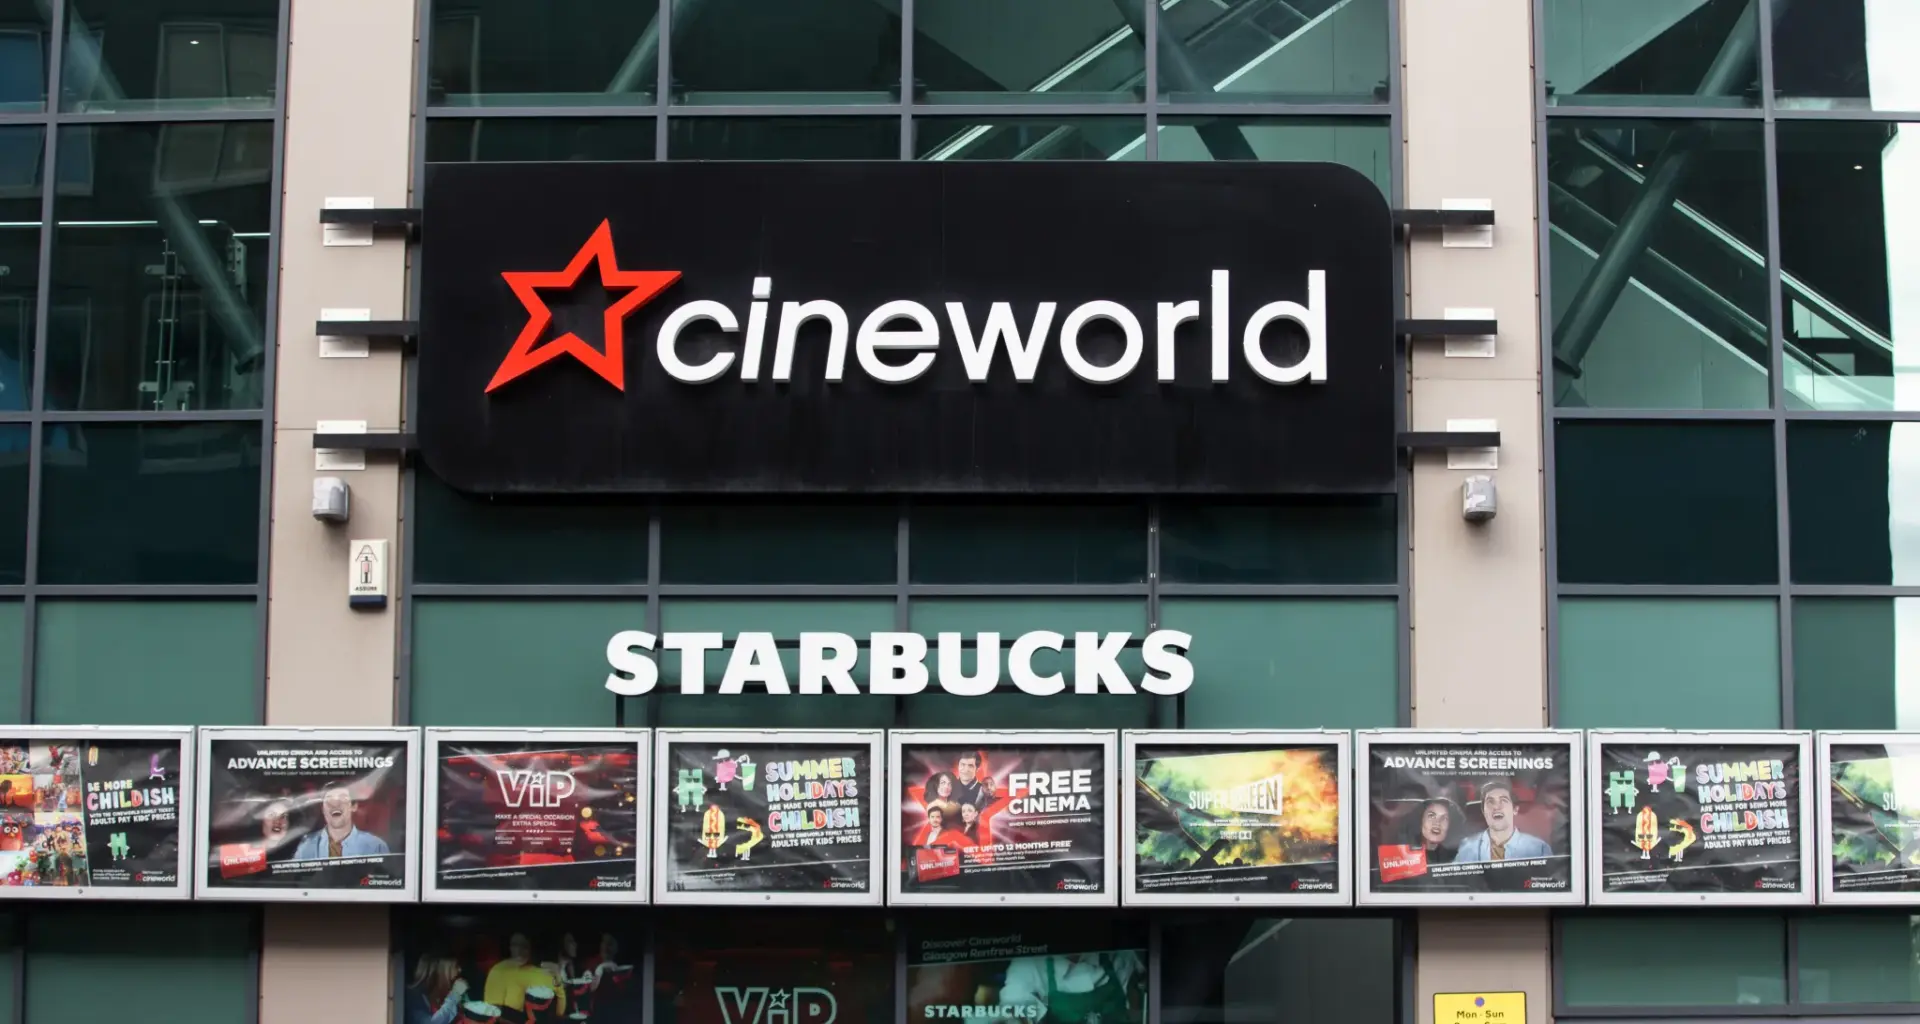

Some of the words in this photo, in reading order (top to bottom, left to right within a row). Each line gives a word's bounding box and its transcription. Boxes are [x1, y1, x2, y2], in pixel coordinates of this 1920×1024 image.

[655, 269, 1327, 386] cineworld
[604, 630, 1195, 697] STARBUCKS
[227, 757, 297, 769] ADVANCE
[299, 756, 394, 769] SCREENINGS
[1383, 757, 1455, 769] ADVANCE
[1459, 757, 1554, 769] SCREENINGS
[765, 757, 856, 782] SUMMER
[1696, 759, 1784, 784] SUMMER
[87, 782, 100, 792] BE
[104, 779, 133, 791] MORE
[1008, 769, 1092, 797] FREE
[766, 779, 858, 802] HOLIDAYS
[1697, 780, 1787, 804] HOLIDAYS
[86, 787, 175, 811] CHILDISH
[1008, 794, 1092, 815] CINEMA
[783, 802, 802, 810] MADE
[90, 817, 116, 826] ADULTS
[151, 812, 176, 821] PRICES
[768, 807, 860, 832] CHILDISH
[1700, 808, 1789, 833] CHILDISH
[771, 840, 799, 848] ADULTS
[836, 835, 862, 844] PRICES
[993, 844, 1004, 852] TO
[1015, 842, 1049, 850] MONTHS
[1704, 841, 1731, 849] ADULTS
[1766, 836, 1791, 845] PRICES
[920, 861, 954, 870] UNLIMITED
[1383, 859, 1421, 869] UNLIMITED
[597, 880, 631, 888] cineworld
[831, 880, 866, 889] cineworld
[1064, 882, 1098, 890] cineworld
[1298, 881, 1333, 890] cineworld
[1762, 881, 1795, 889] cineworld
[922, 939, 967, 949] Discover
[968, 934, 1022, 946] Cineworld
[922, 951, 968, 962] Glasgow
[969, 947, 1013, 959] Renfrew
[1015, 944, 1048, 954] Street
[924, 1004, 1037, 1018] STARBUCKS
[1456, 1010, 1477, 1019] Mon
[1485, 1010, 1504, 1019] Sun
